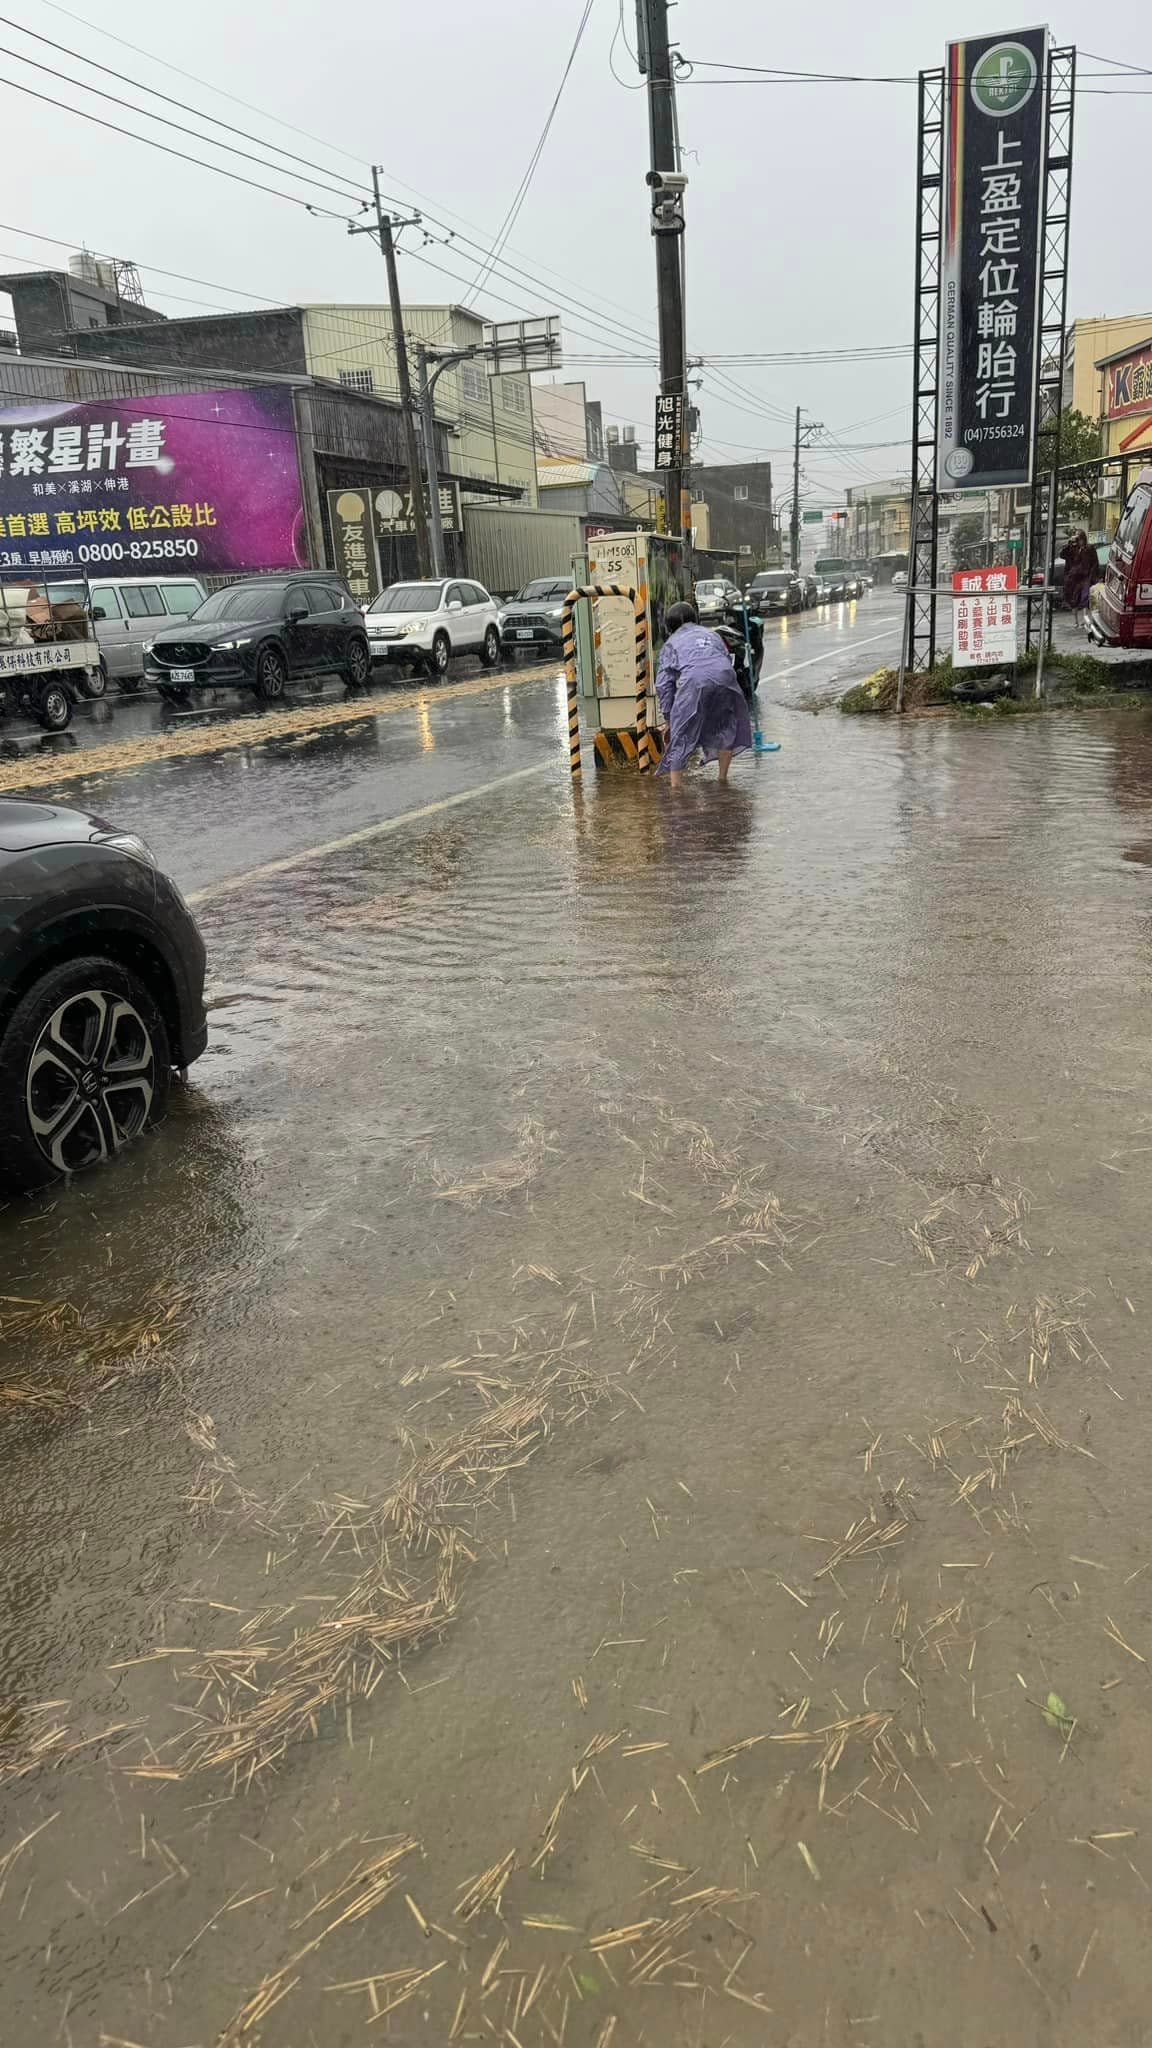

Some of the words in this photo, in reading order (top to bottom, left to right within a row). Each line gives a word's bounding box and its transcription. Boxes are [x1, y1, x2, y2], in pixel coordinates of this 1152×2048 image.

[975, 130, 1023, 419] 上盈定位輪胎行
[946, 281, 956, 327] GERMAN
[945, 331, 955, 377] QUALITY
[944, 381, 953, 413] SINCE
[0, 419, 166, 478] 繁星計畫
[656, 397, 674, 467] 旭光健身
[964, 424, 1025, 444] (04)7556324
[0, 511, 50, 538] 首選
[54, 508, 121, 535] 高坪效
[126, 502, 216, 531] 低公設比
[29, 549, 74, 565] 早鳥預約
[78, 539, 198, 562] 0800-825850
[341, 524, 370, 596] 友進汽車
